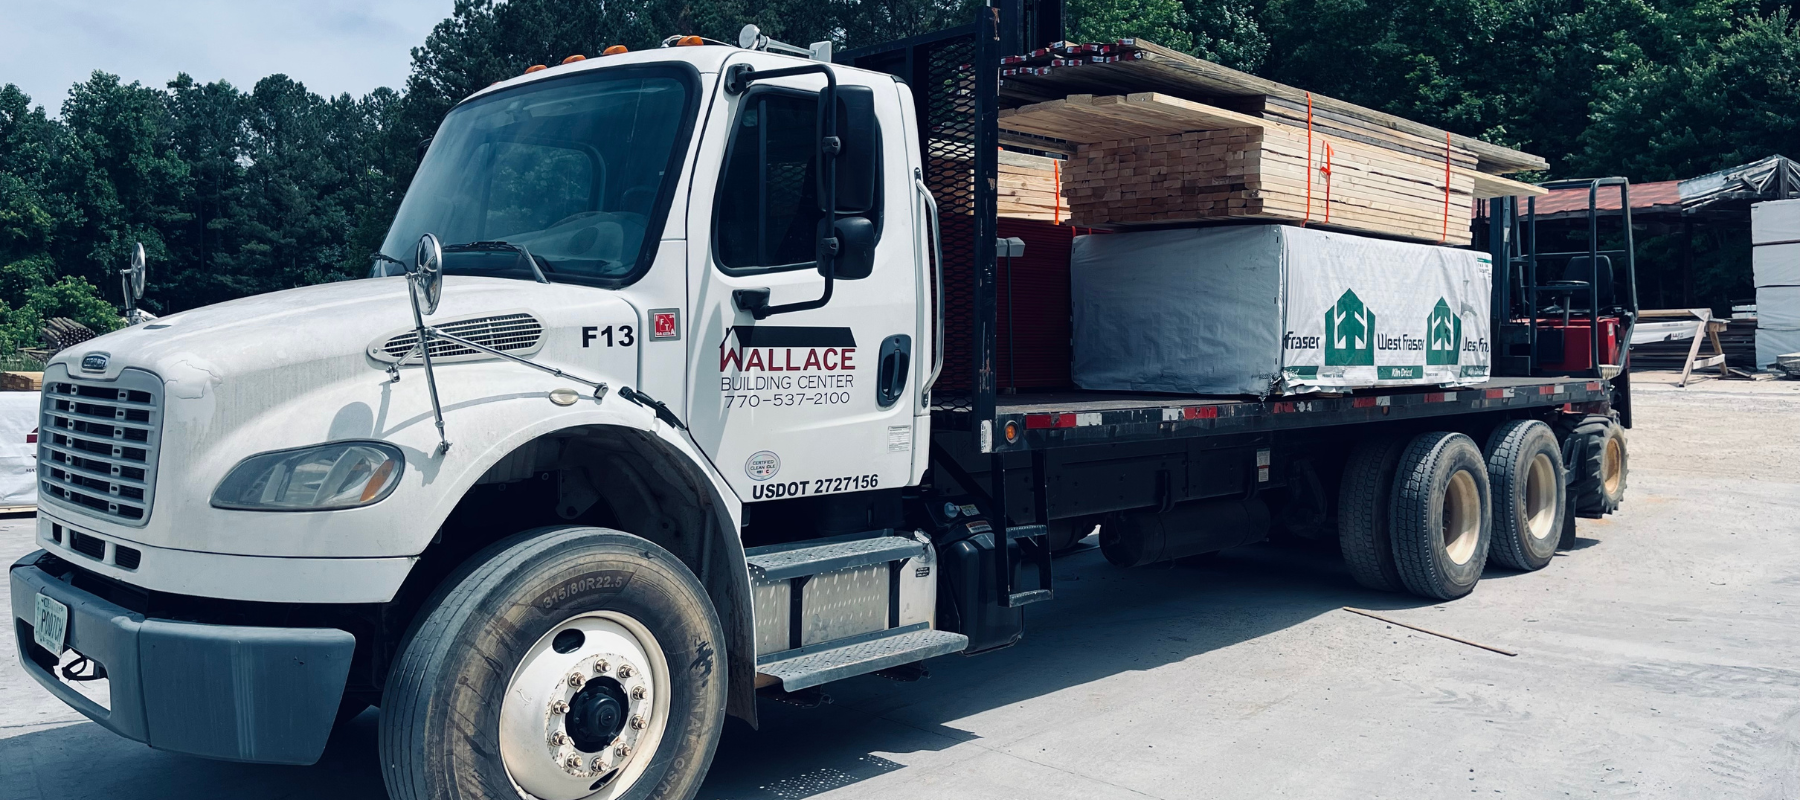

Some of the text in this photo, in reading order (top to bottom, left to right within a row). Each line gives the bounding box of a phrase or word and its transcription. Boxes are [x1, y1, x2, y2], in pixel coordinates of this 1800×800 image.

[582, 325, 634, 347] F13
[1377, 333, 1401, 350] West
[720, 344, 856, 372] WALLACE
[721, 375, 854, 391] BUILDING CENTER
[724, 392, 850, 408] 770-537-2100
[752, 474, 879, 499] USDOT 2727156
[543, 576, 624, 609] 315/80R22.5
